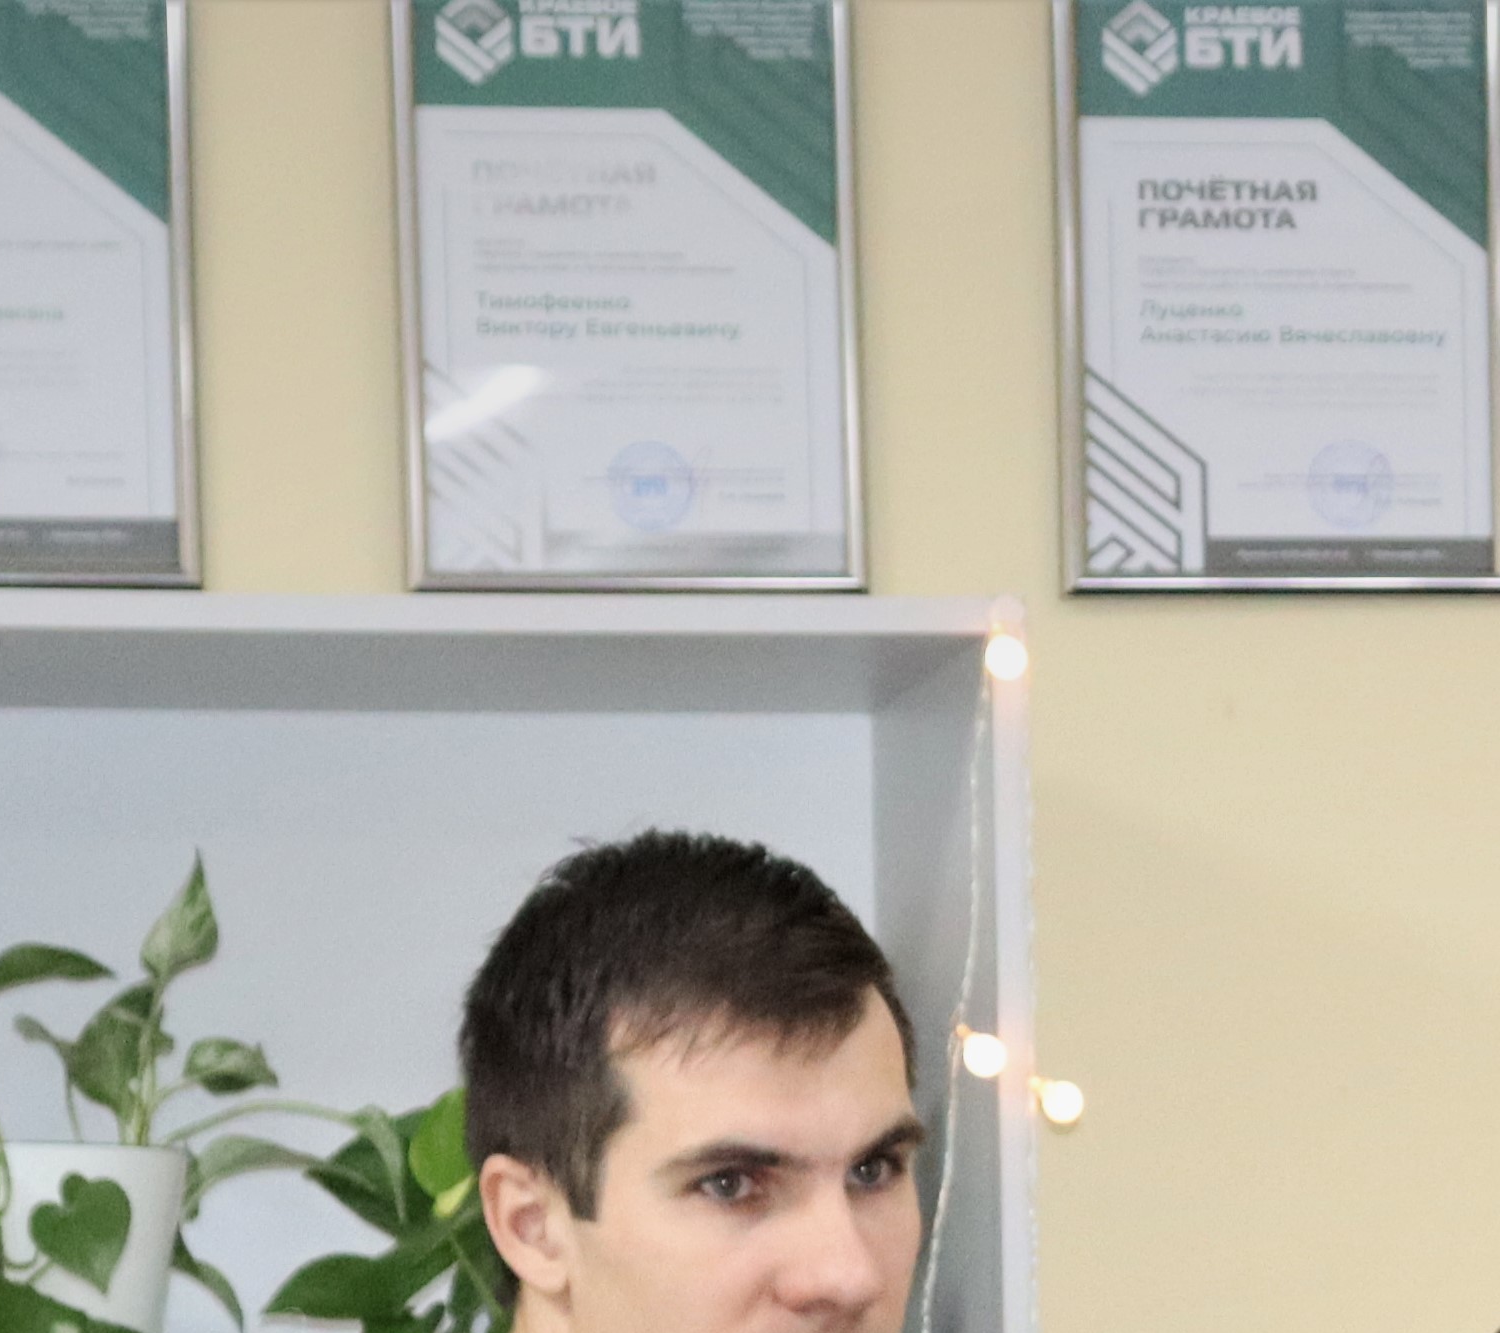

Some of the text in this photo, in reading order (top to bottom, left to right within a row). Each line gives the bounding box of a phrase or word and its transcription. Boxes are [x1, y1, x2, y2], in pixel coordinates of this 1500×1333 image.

[1184, 6, 1300, 24] КРАЕВОЕ
[520, 16, 640, 58] БТИ
[1184, 27, 1303, 69] БТИ
[1139, 175, 1318, 203] ПОЧЁТНАЯ
[1139, 207, 1298, 231] ГРАМОТА
